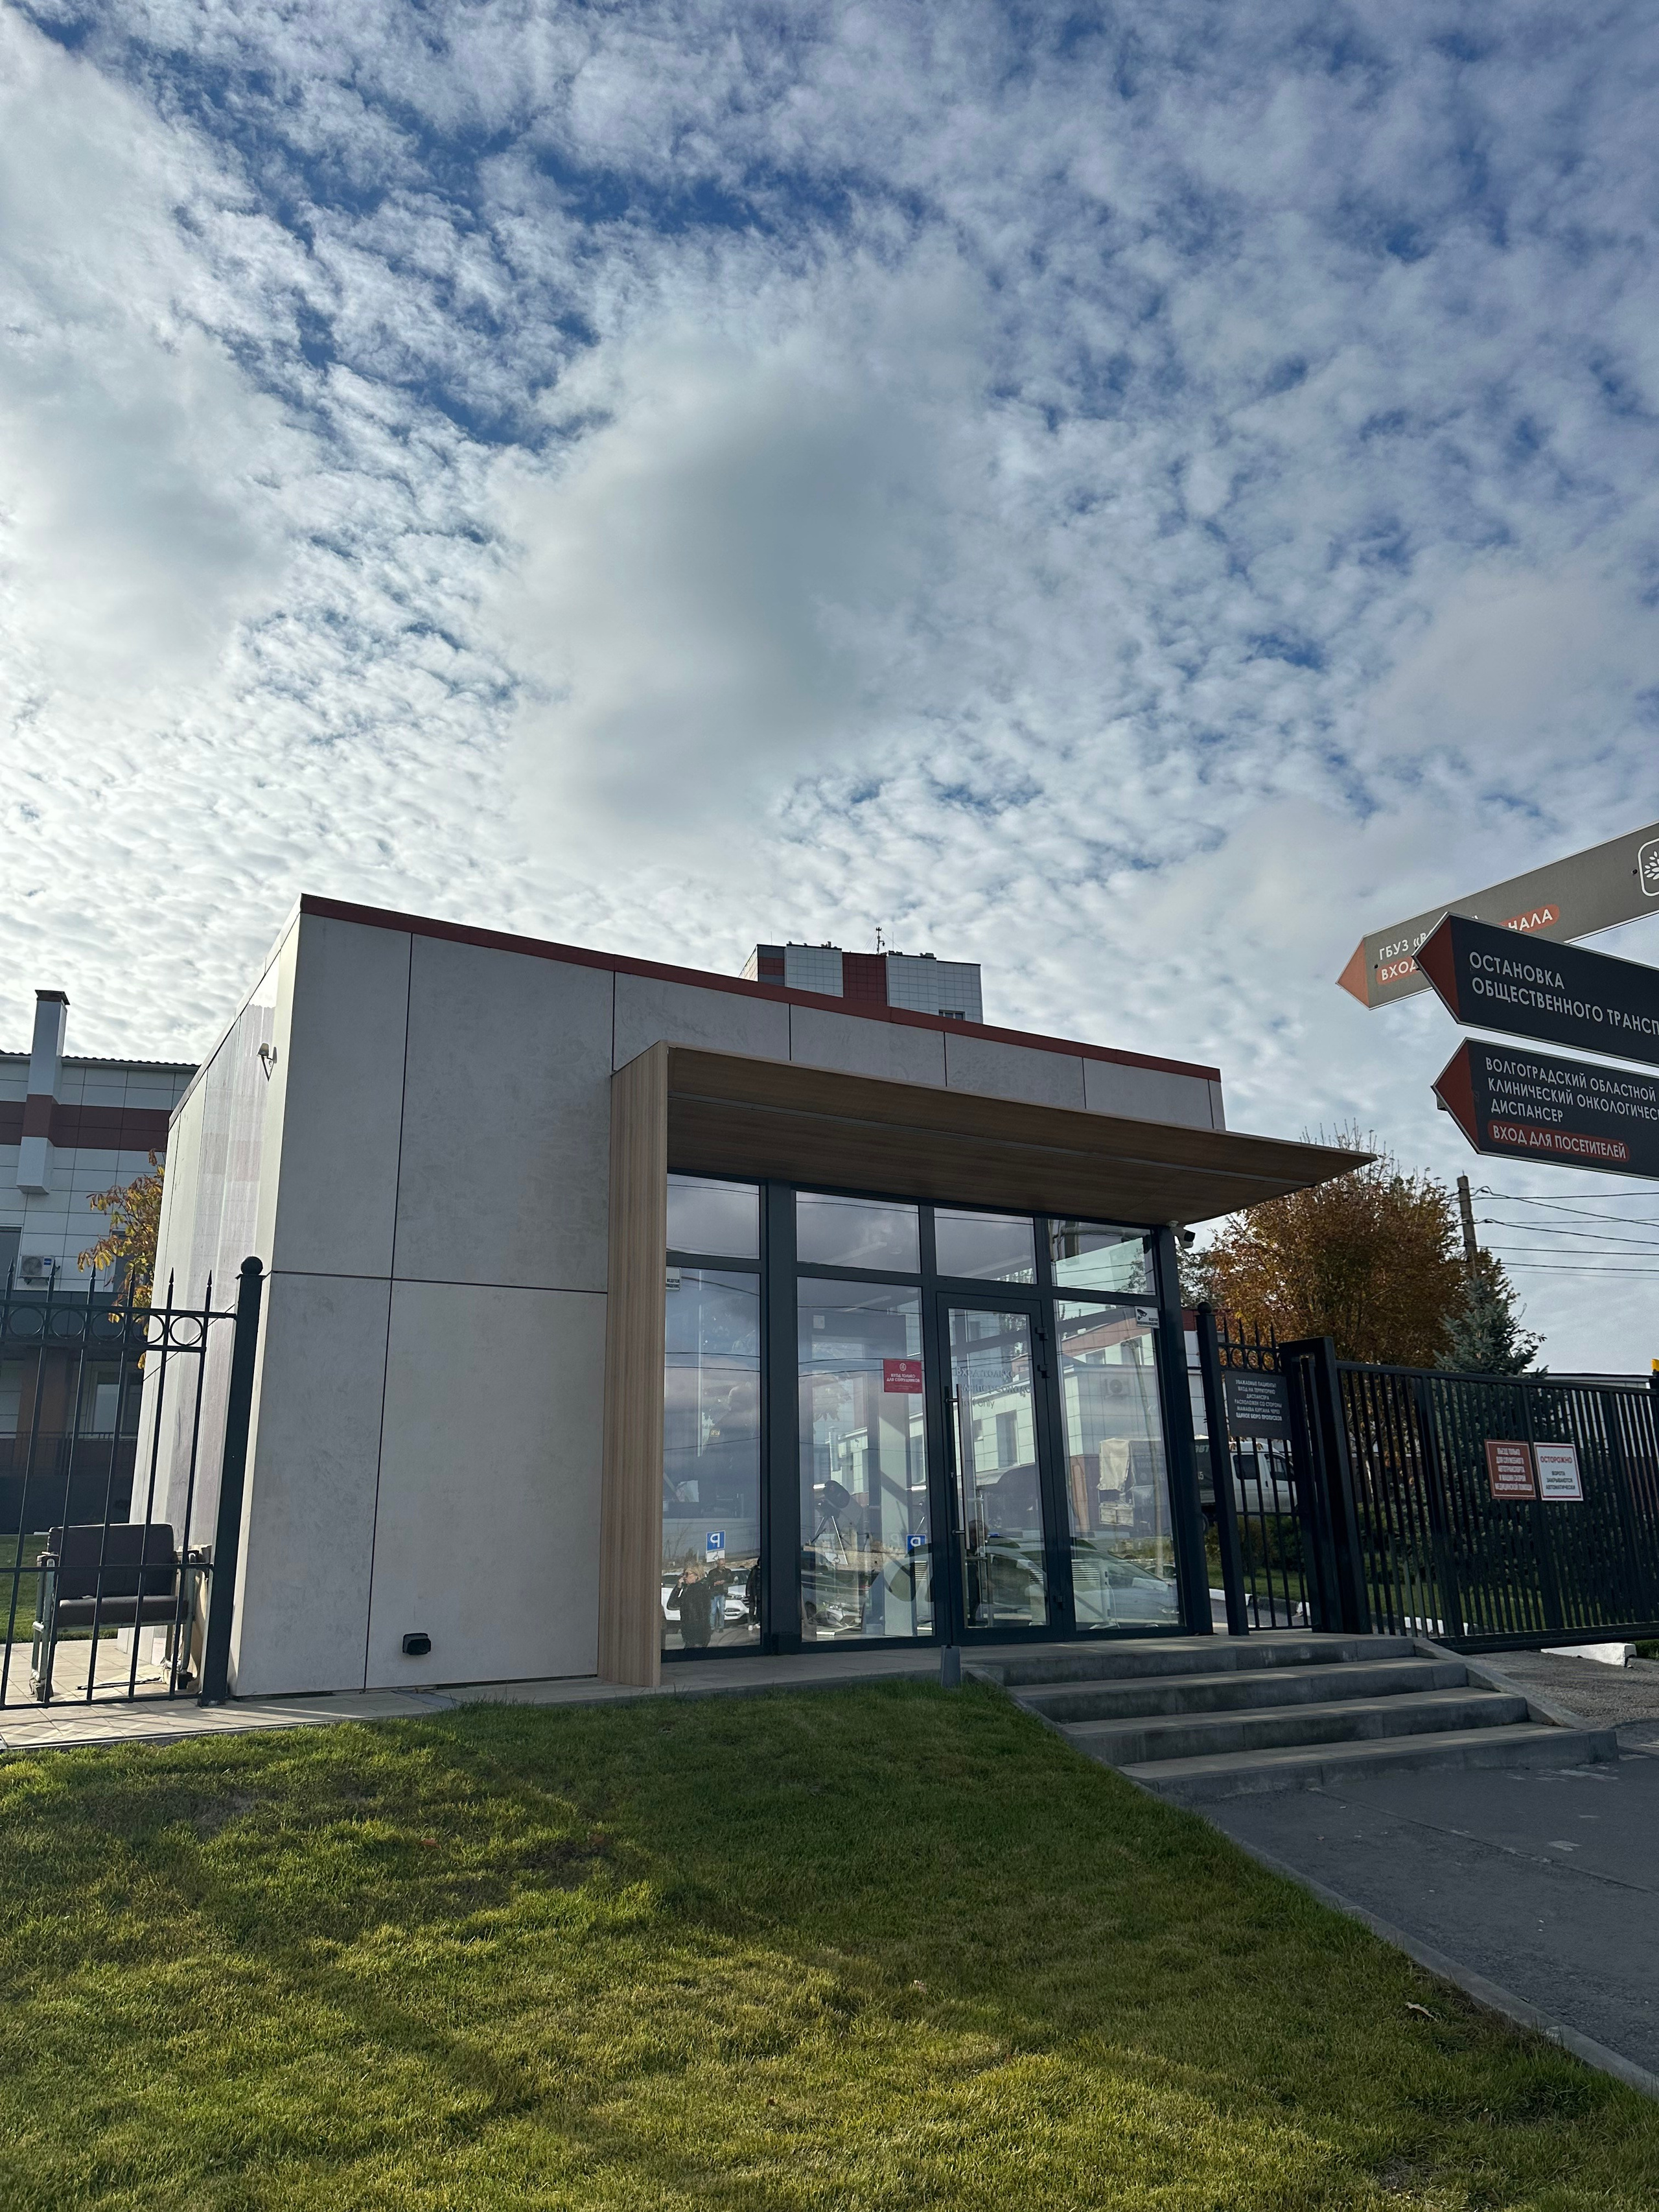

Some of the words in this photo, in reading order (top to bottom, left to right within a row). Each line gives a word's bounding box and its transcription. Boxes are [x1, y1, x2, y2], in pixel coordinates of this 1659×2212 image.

[1507, 909, 1553, 931] НАЛА
[1379, 939, 1409, 960] ГБУЗ
[1469, 951, 1565, 990] ОСТАНОВКА
[1472, 977, 1603, 1023] ОБЩЕСТВЕННОГО
[1485, 1057, 1587, 1088] ВОЛГОГРАДСКИЙ
[1590, 1077, 1656, 1102] ОБЛАСТНОЙ
[1488, 1077, 1573, 1106] КЛИНИЧЕСКИЙ
[1577, 1094, 1659, 1121] ОНКОЛОГИЧЕС
[1491, 1099, 1564, 1123] ДИСПАНСЕР
[1492, 1125, 1527, 1145] ВХОД
[1529, 1132, 1552, 1147] ДЛЯ
[1555, 1135, 1626, 1159] ПОСЕТИТЕЛЕЙ
